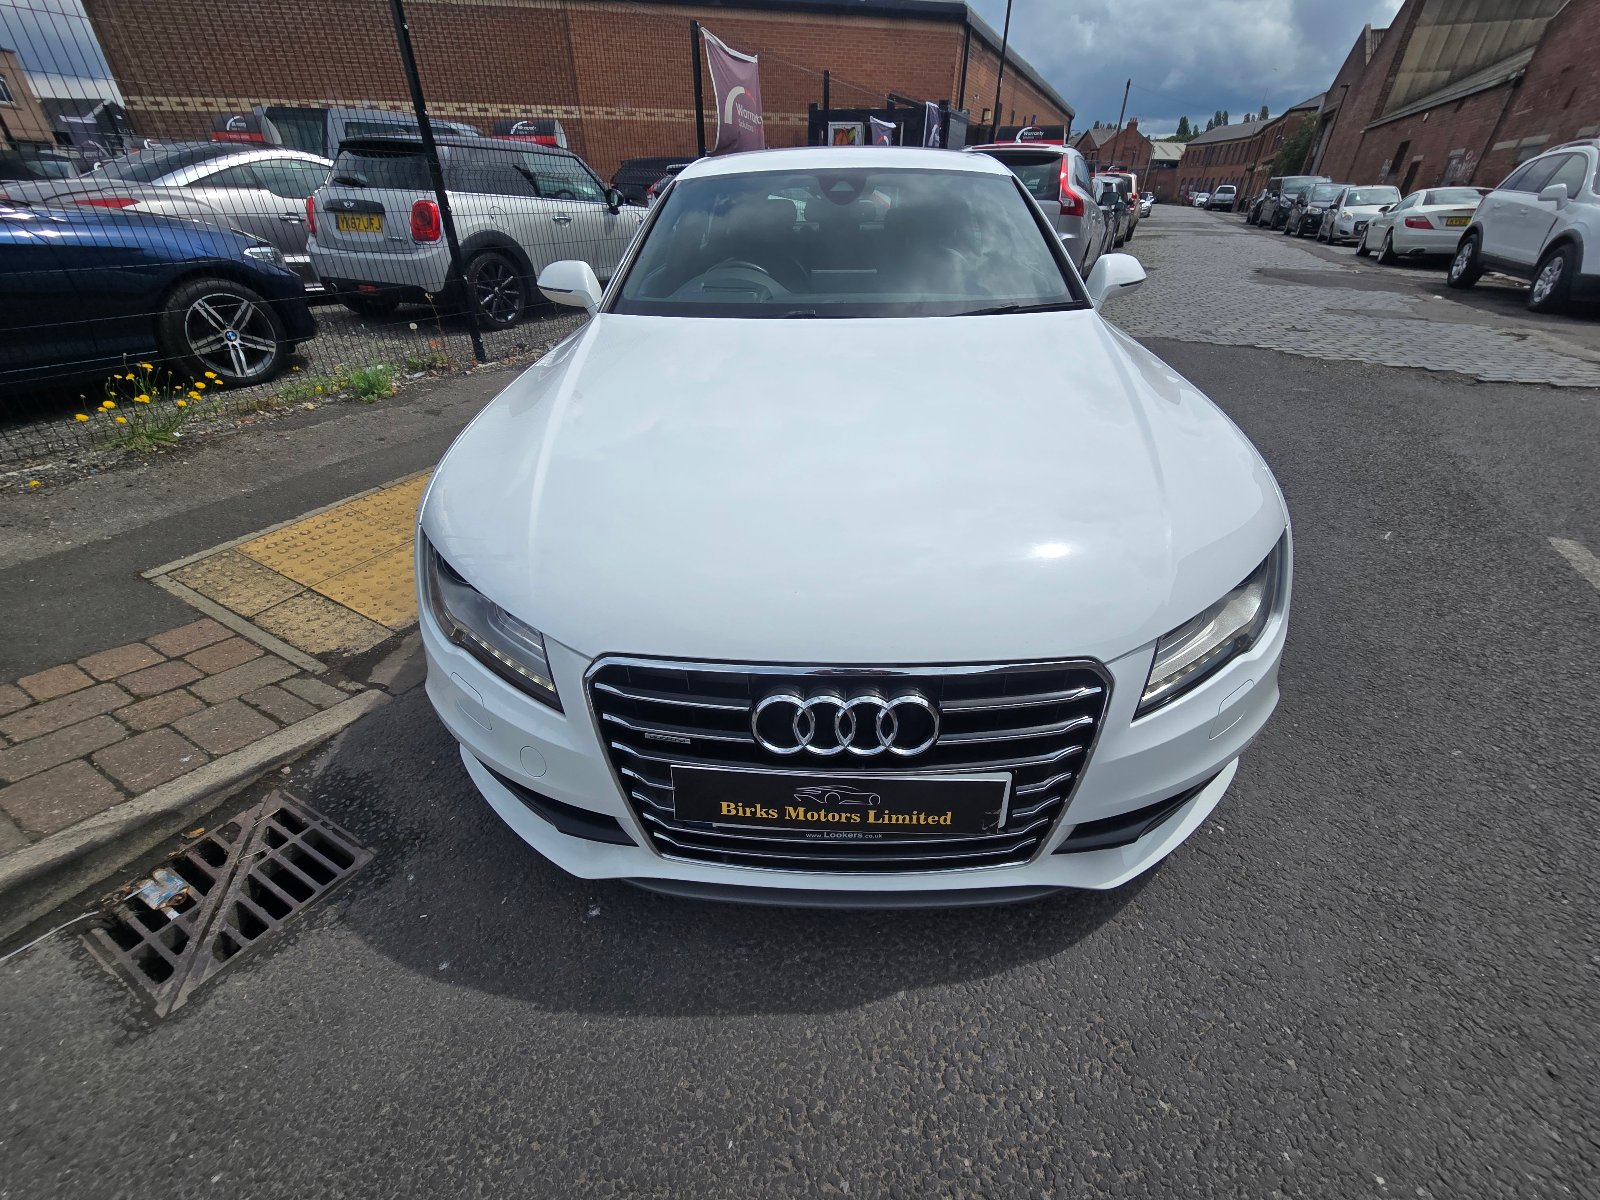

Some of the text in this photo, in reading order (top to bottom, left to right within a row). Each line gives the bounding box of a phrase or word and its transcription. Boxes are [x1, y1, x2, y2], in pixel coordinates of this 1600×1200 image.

[720, 801, 952, 825] Birks Motors Limited
